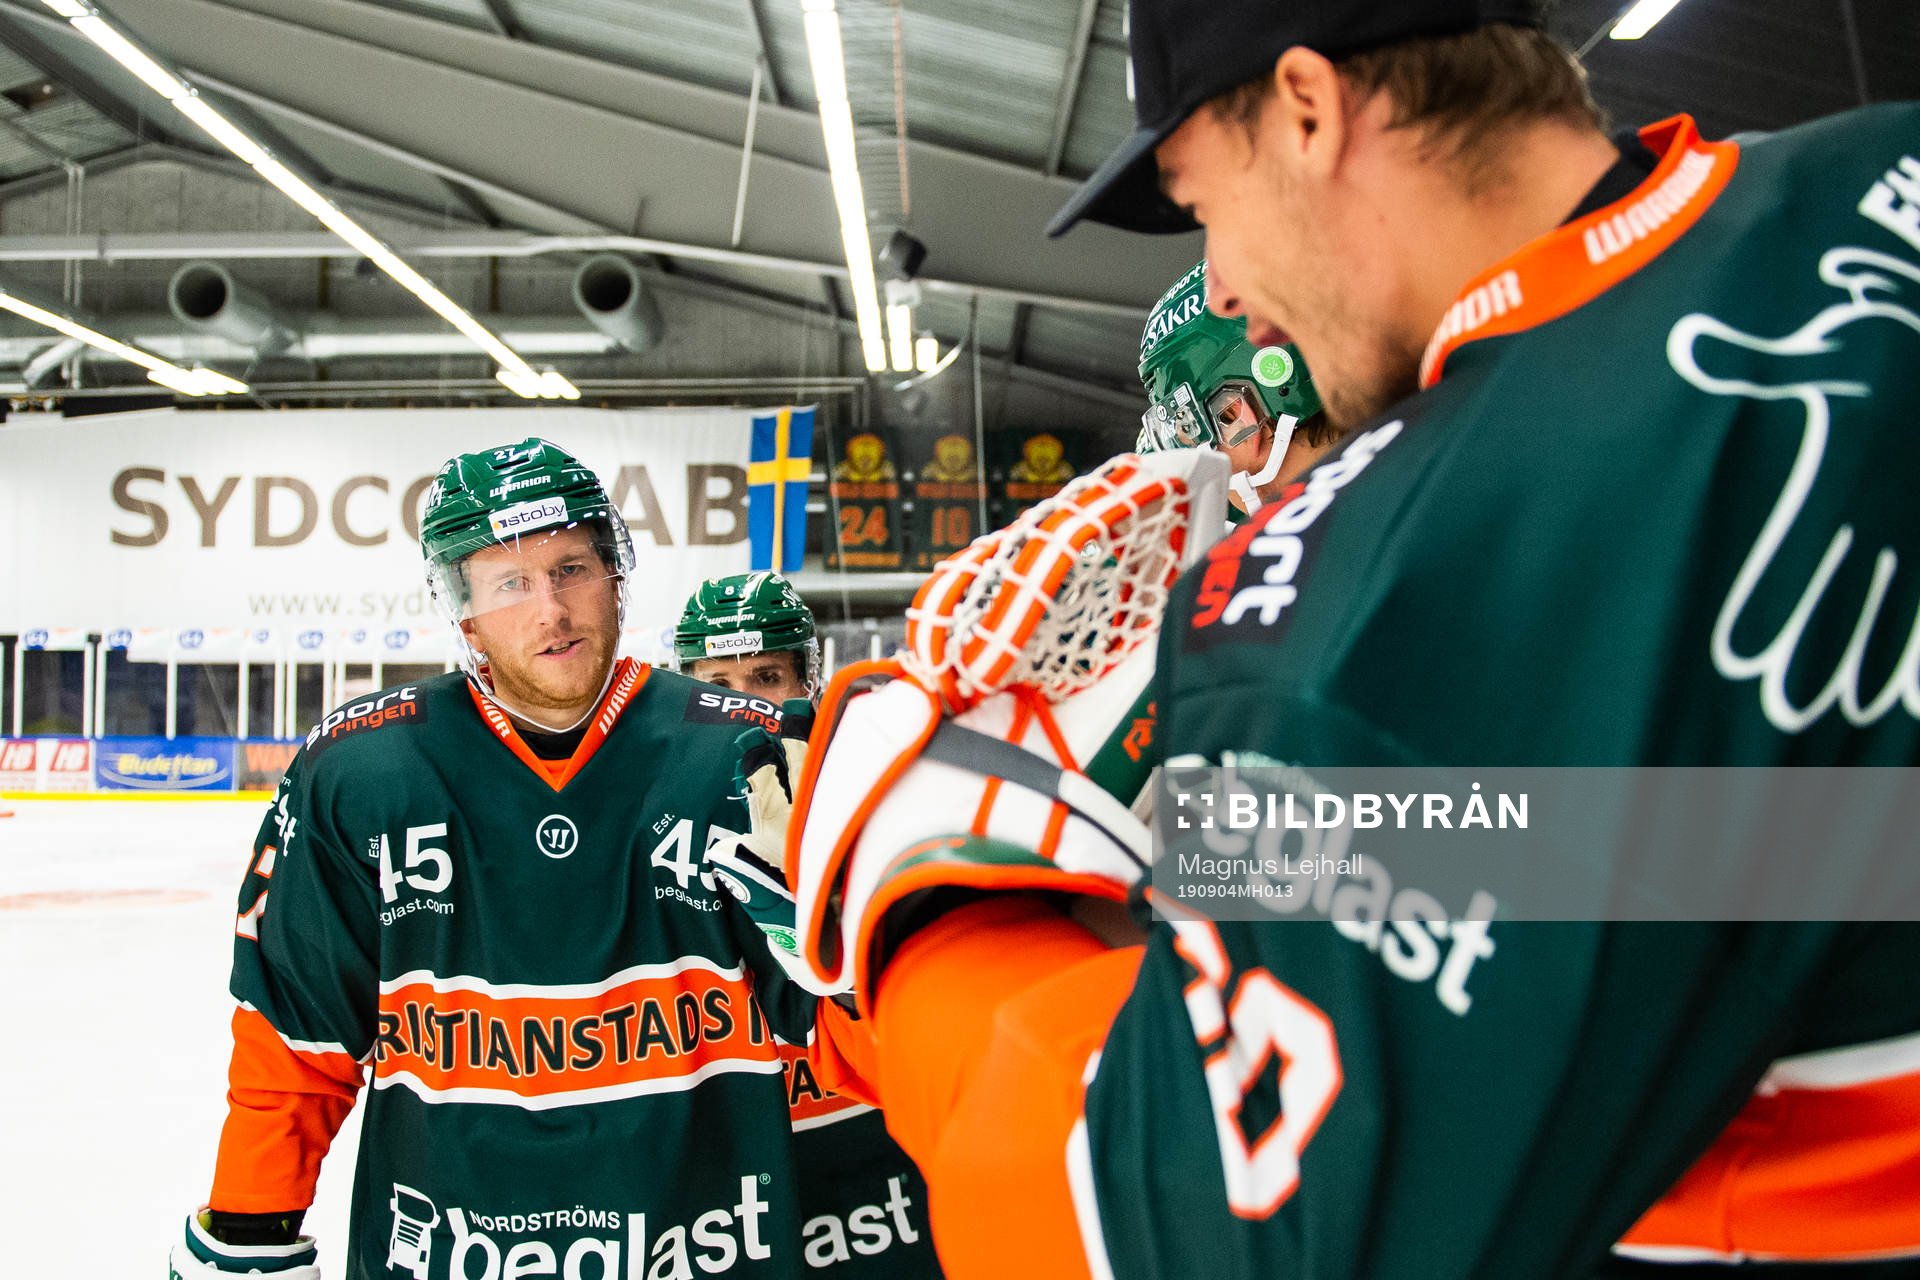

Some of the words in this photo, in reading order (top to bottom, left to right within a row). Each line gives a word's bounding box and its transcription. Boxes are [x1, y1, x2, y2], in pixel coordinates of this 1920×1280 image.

[494, 447, 516, 461] 27
[489, 474, 551, 498] WARRIOR
[508, 503, 566, 527] stoby
[839, 505, 889, 546] 24
[248, 586, 437, 623] www.syd
[716, 635, 762, 650] stoby
[599, 658, 644, 736] WARRIO
[306, 686, 418, 751] sport
[331, 701, 417, 739] ringen
[730, 708, 781, 734] ring
[653, 812, 675, 835] Est.
[368, 834, 380, 858] Est.
[380, 898, 454, 926] glast.com
[654, 886, 723, 912] beglast.c
[375, 986, 735, 1079] RISTIANSTADS
[468, 1205, 621, 1233] NORDSTRÖMS
